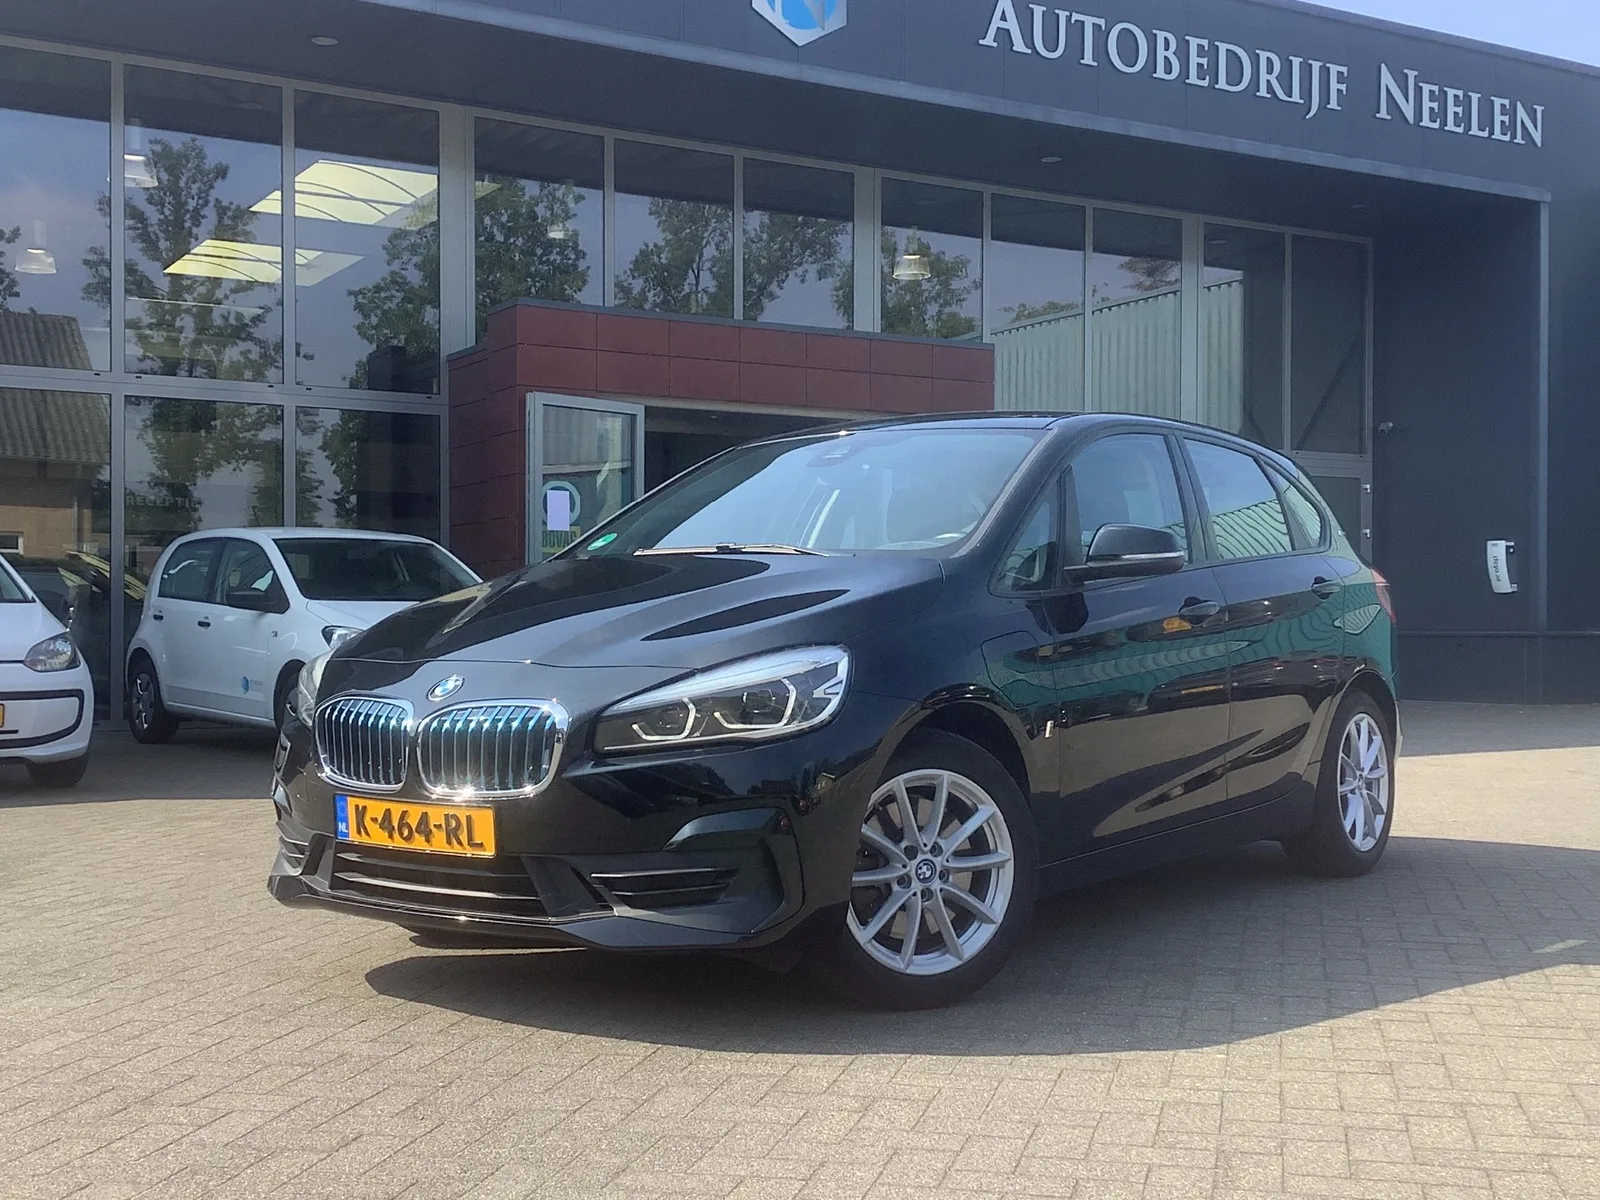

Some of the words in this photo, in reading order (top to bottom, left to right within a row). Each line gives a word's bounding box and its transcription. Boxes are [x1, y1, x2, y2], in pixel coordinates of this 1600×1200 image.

[978, 0, 1348, 119] AUTOBEDRIJF
[1375, 62, 1545, 148] NEELEN
[338, 821, 349, 833] NL
[354, 804, 484, 849] K-464-RL
